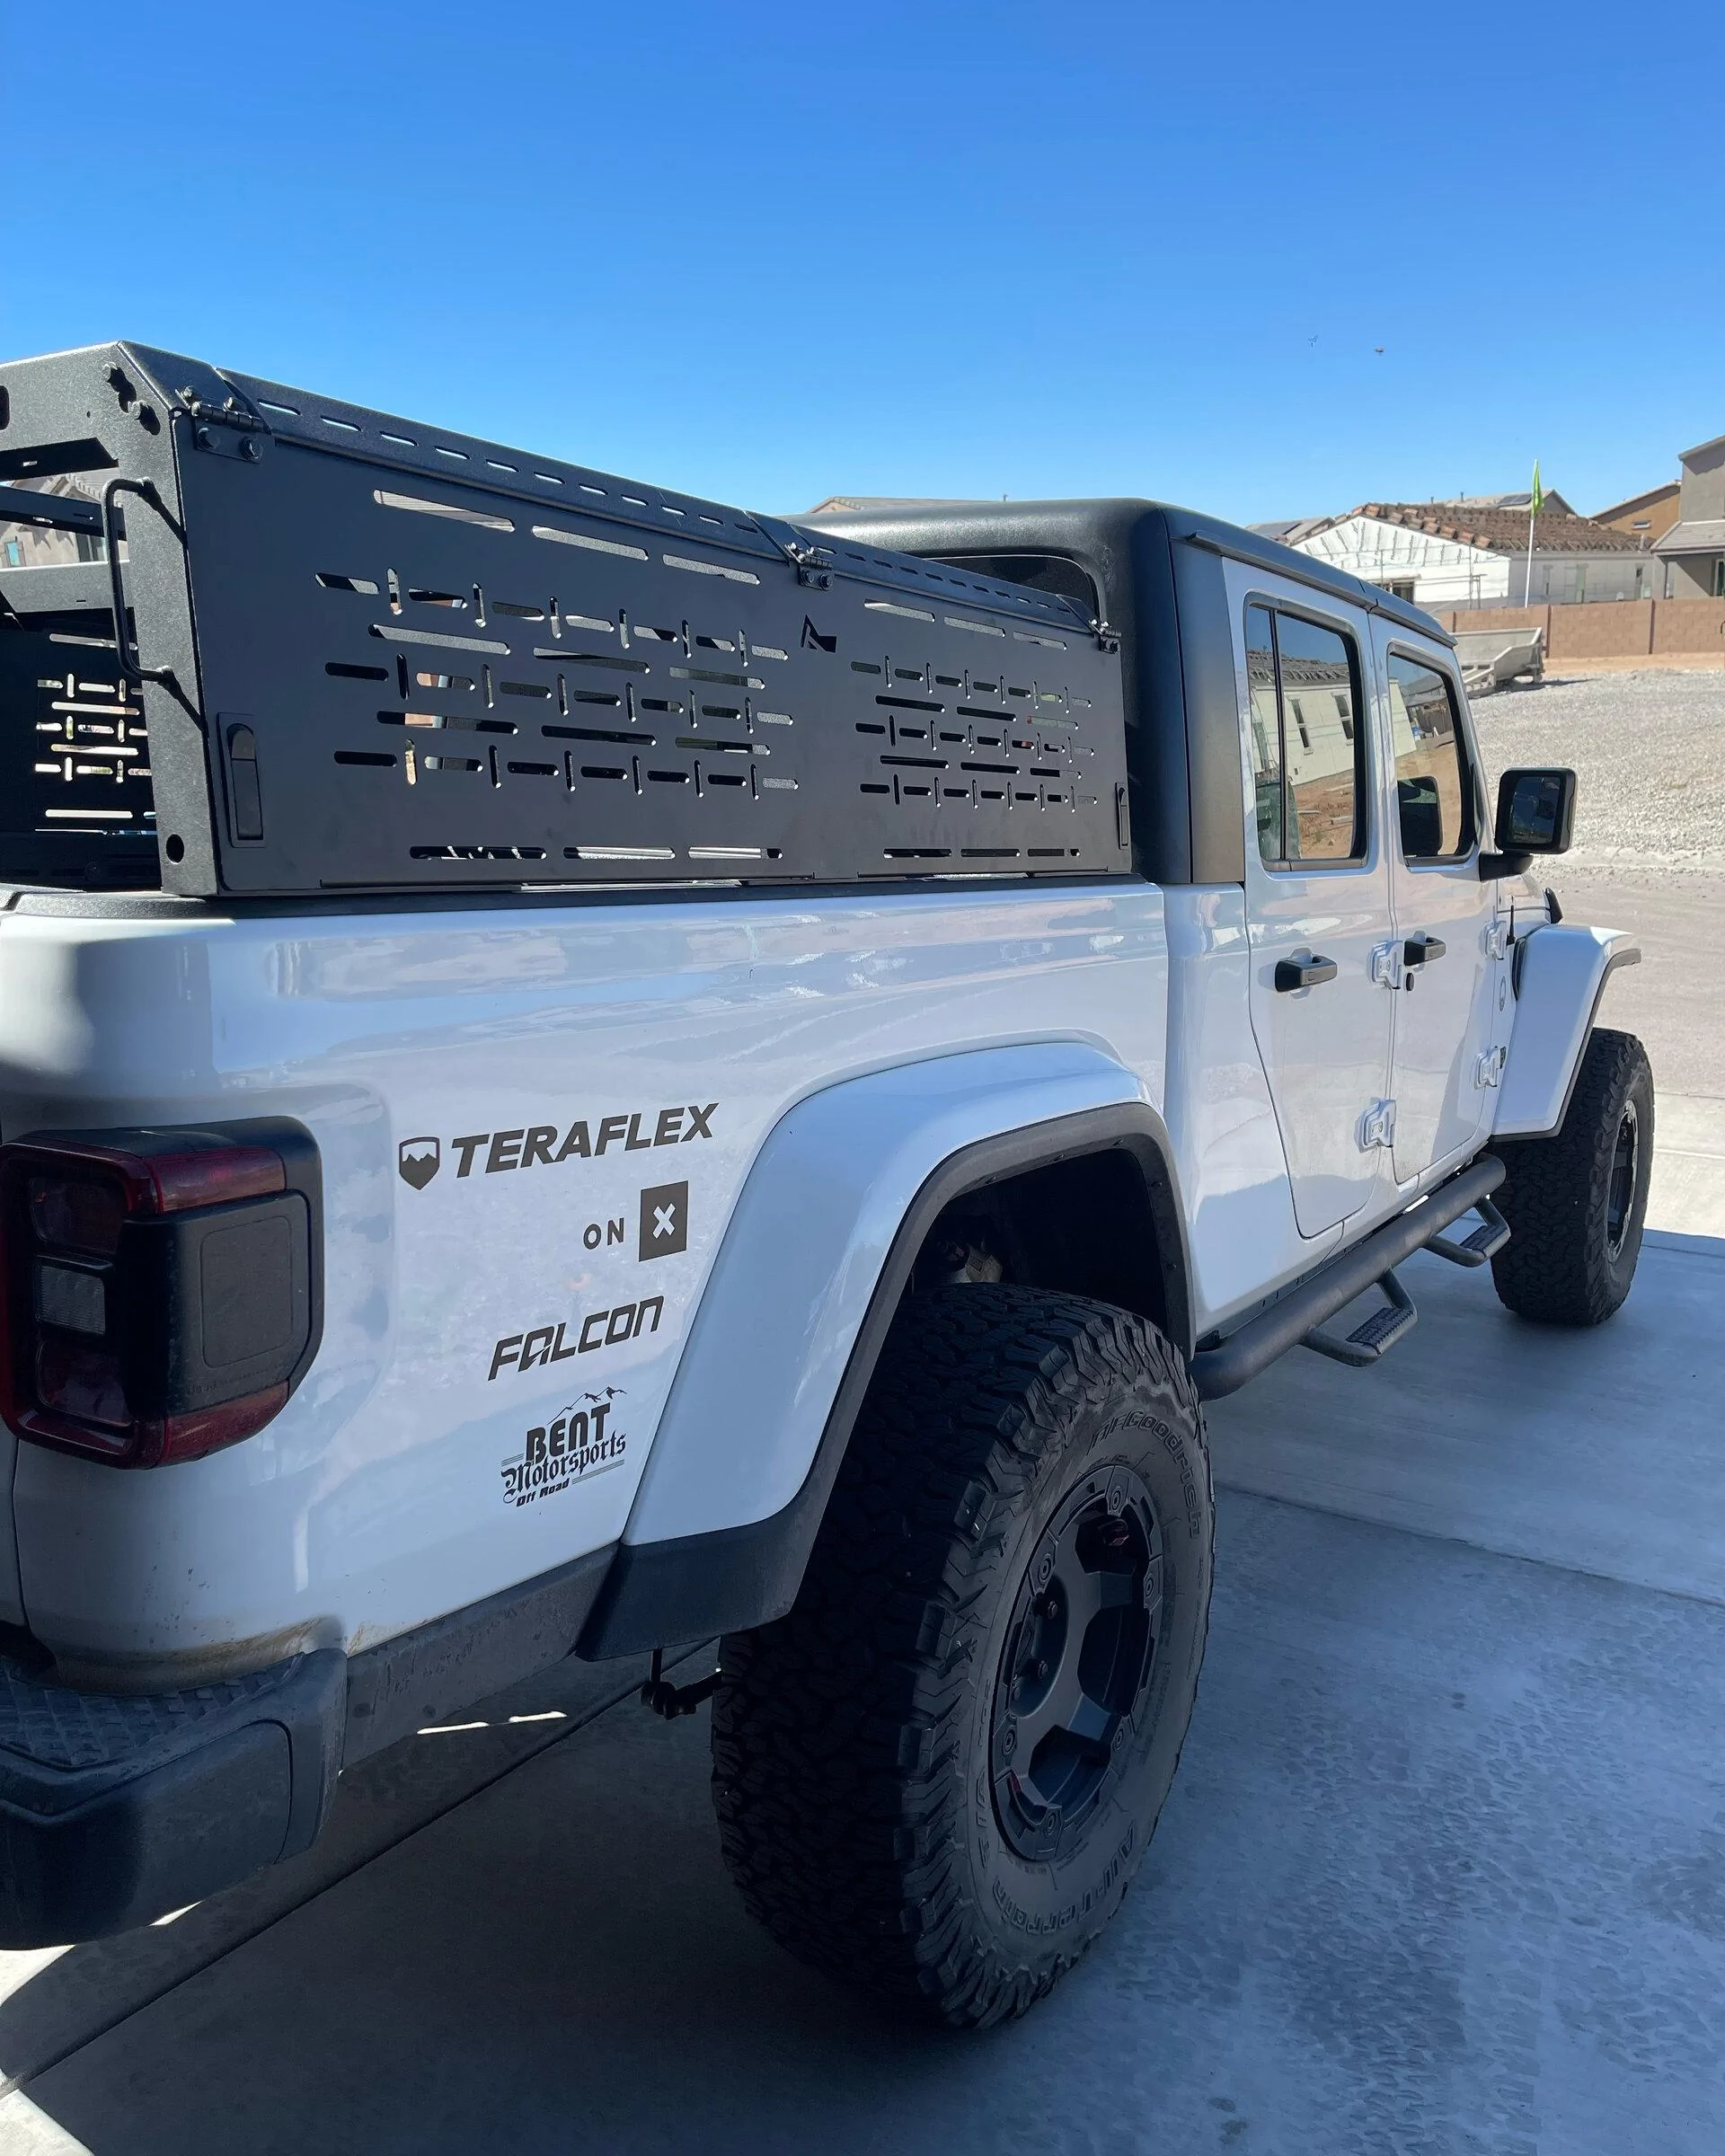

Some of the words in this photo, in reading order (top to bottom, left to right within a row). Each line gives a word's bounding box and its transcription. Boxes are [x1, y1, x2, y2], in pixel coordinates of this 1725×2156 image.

[451, 1102, 719, 1179] TERAFLEX
[583, 1217, 624, 1250] ON
[488, 1295, 664, 1381] FALCON
[500, 1429, 627, 1504] Motorsports
[526, 1402, 611, 1465] BENT
[539, 1478, 571, 1498] Road
